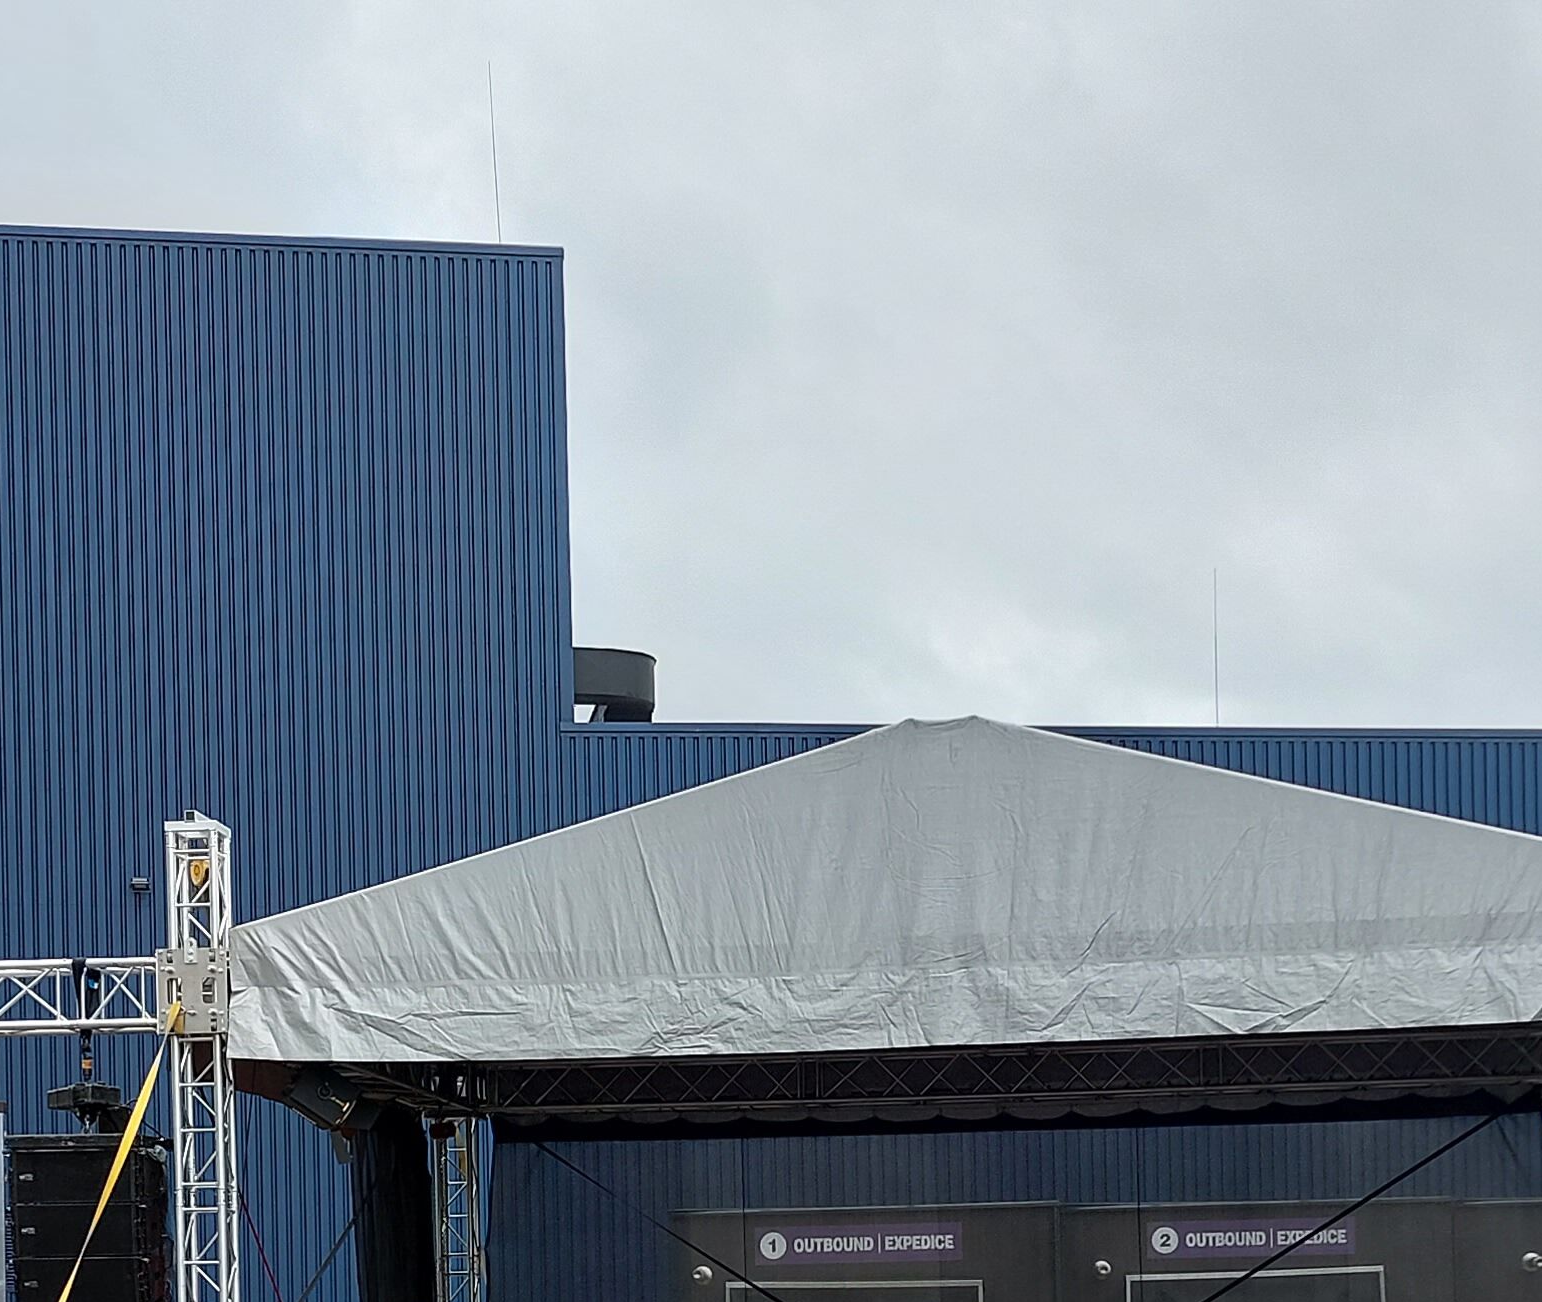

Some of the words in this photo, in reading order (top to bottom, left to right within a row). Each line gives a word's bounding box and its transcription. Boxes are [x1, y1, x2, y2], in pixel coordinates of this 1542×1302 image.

[793, 1236, 874, 1253] OUTBOUND
[884, 1234, 955, 1250] EXPEDICE
[1185, 1231, 1266, 1248] OUTBOUND
